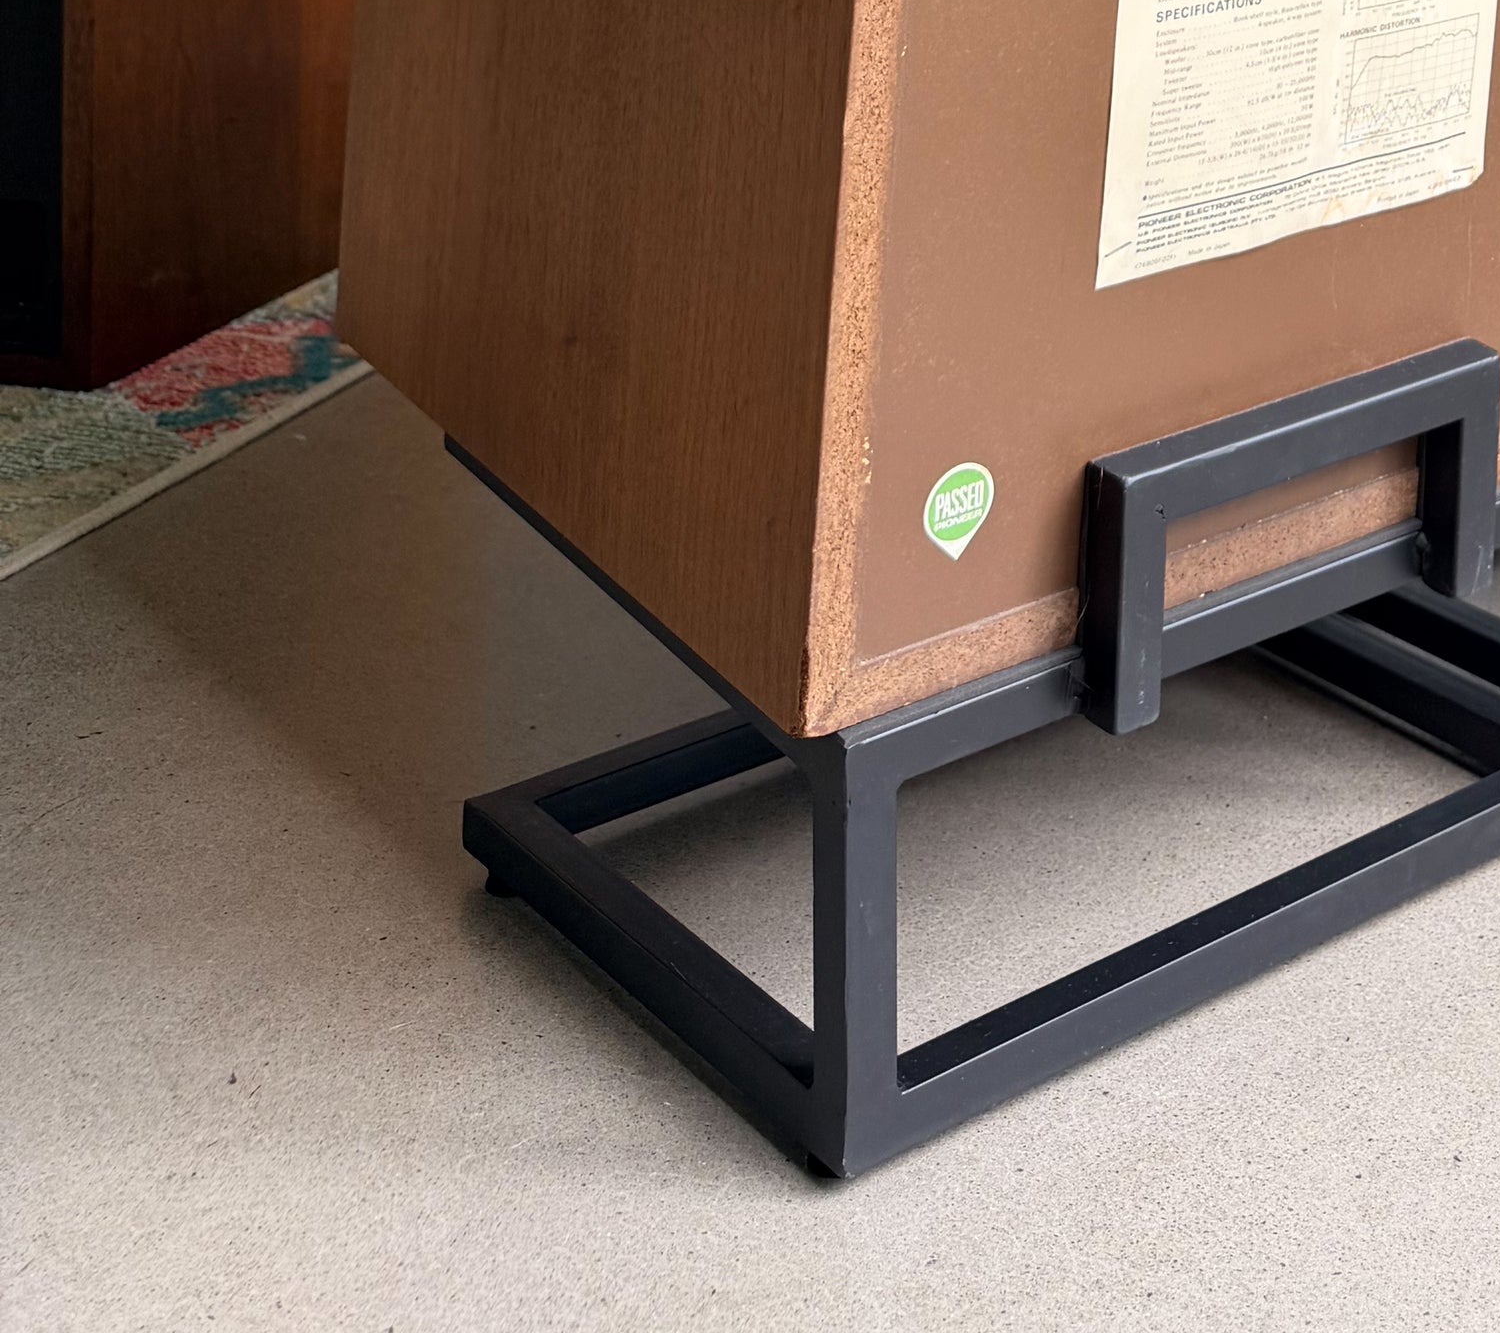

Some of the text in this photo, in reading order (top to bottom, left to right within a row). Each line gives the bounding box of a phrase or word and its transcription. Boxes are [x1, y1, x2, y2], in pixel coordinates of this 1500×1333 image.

[1137, 211, 1181, 230] PIONEER
[1185, 195, 1245, 218] ELECTRONIC
[1249, 178, 1311, 202] CORPORATION
[934, 480, 984, 523] PASSED
